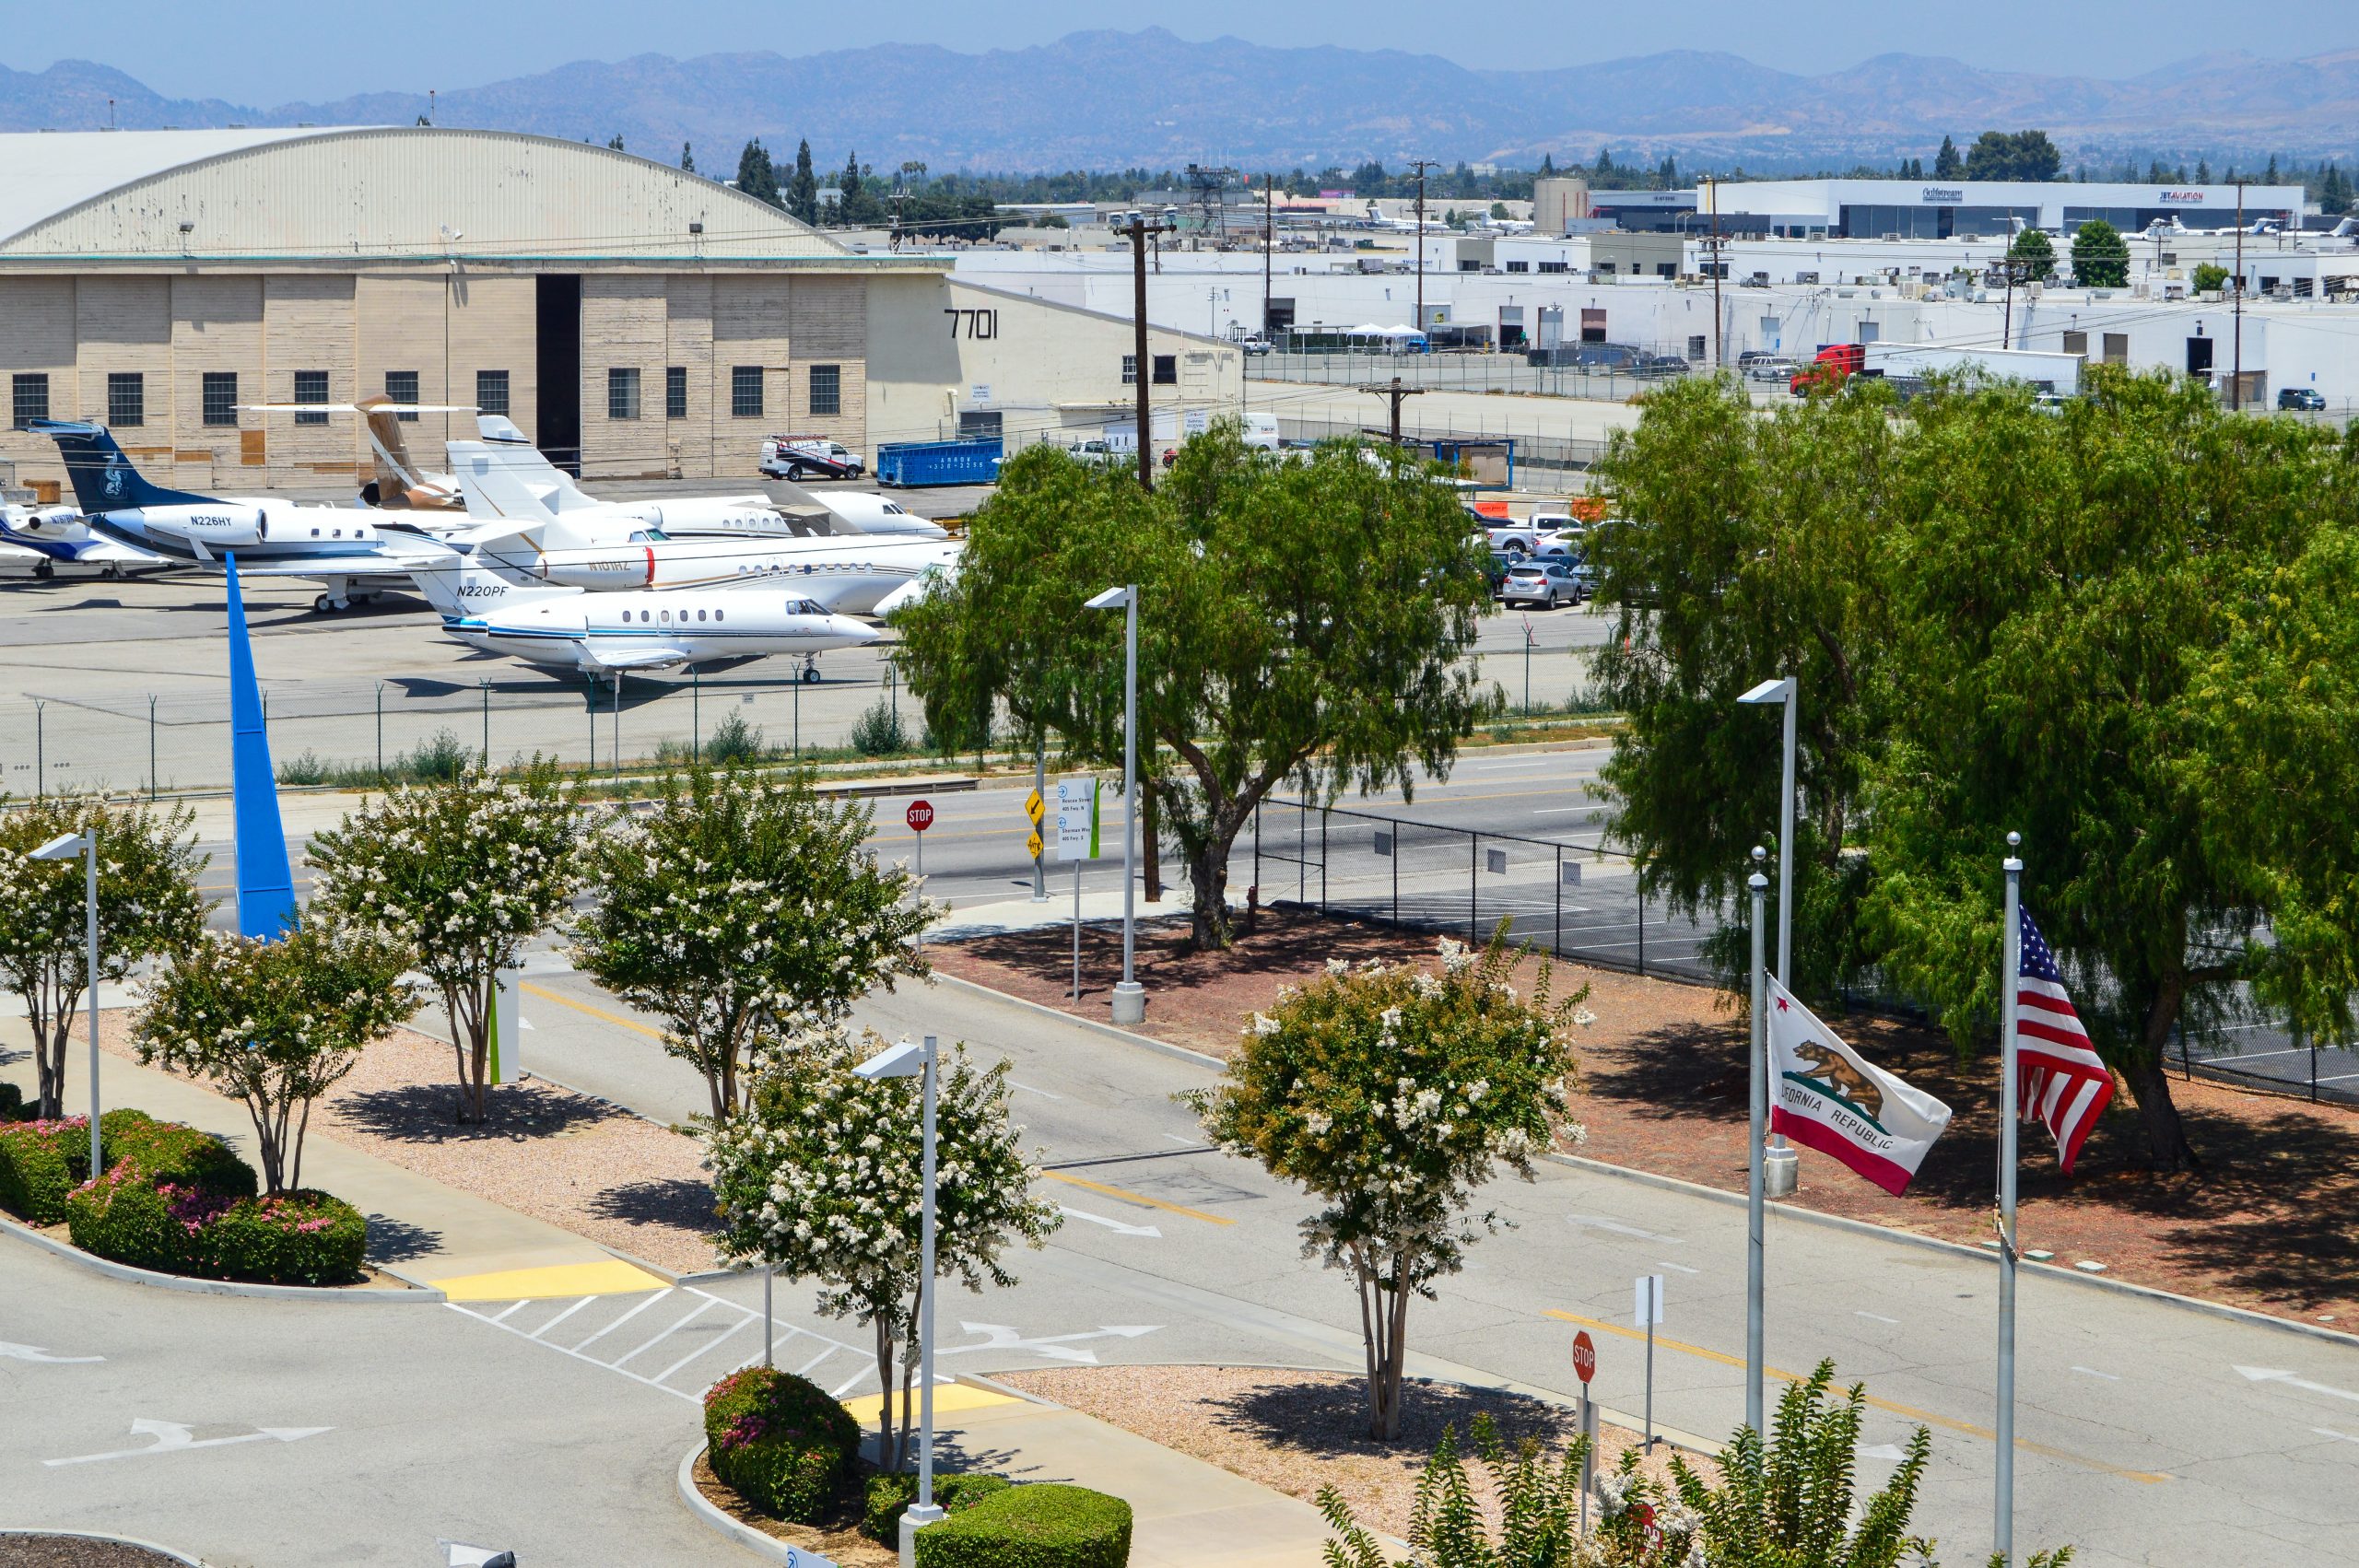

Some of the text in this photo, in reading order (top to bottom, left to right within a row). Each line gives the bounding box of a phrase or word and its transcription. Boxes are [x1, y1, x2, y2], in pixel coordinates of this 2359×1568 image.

[1922, 187, 1963, 197] Gulfstream
[944, 309, 998, 339] 7701
[190, 515, 231, 526] N226HY
[456, 585, 510, 597] N220PF
[909, 809, 932, 823] STOP
[1830, 1109, 1894, 1150] REPUBLIC
[1574, 1344, 1594, 1369] STOP
